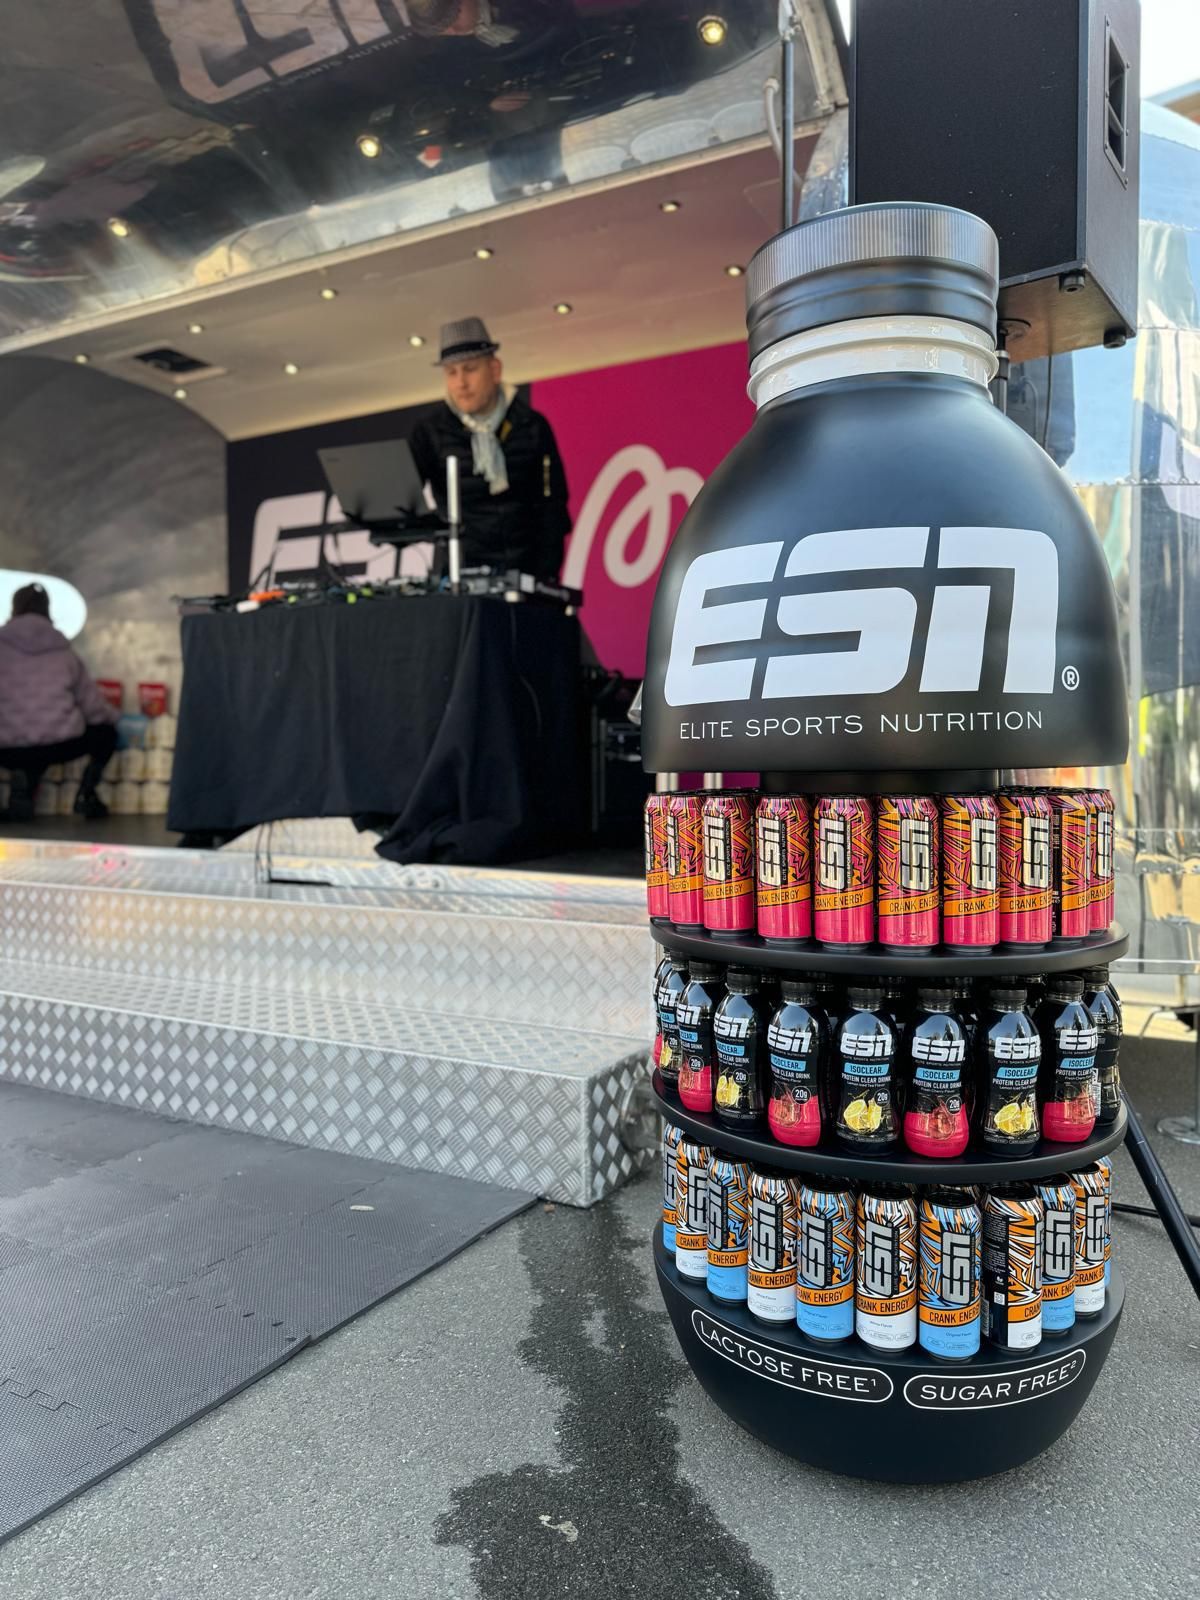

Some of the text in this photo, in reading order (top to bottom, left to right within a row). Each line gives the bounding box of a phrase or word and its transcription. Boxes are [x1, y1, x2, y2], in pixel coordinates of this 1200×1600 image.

[679, 710, 1043, 741] ELITE SPORTS NUTRITION
[716, 883, 742, 897] ENERGY
[771, 889, 799, 904] ENERGY
[833, 892, 864, 907] ENERGY
[889, 899, 917, 913] CRANK
[1009, 897, 1037, 911] CRANK
[958, 900, 986, 913] CRANK
[840, 1032, 892, 1057] ESN
[911, 1036, 965, 1062] ESN
[736, 1072, 747, 1081] 20g
[780, 1069, 795, 1078] CLEAR
[796, 1072, 811, 1080] DRINK
[841, 1072, 892, 1084] PROTEIN CLEAR DRINK
[1056, 1068, 1076, 1077] PROTEIN
[912, 1078, 932, 1088] PROTEIN
[992, 1078, 1014, 1086] PROTEIN
[794, 1089, 808, 1099] 20g
[877, 1092, 888, 1102] 20g
[680, 1236, 700, 1248] CRANK
[713, 1253, 739, 1265] ENERGY
[765, 1275, 794, 1286] ENERGY
[1075, 1273, 1099, 1287] CRANK
[814, 1289, 844, 1303] ENERGY
[880, 1301, 910, 1313] ENERGY
[1024, 1302, 1042, 1318] CRAN
[929, 1311, 956, 1324] CRANK
[700, 1320, 796, 1380] LACTOSE
[919, 1382, 1012, 1403] SUGAR
